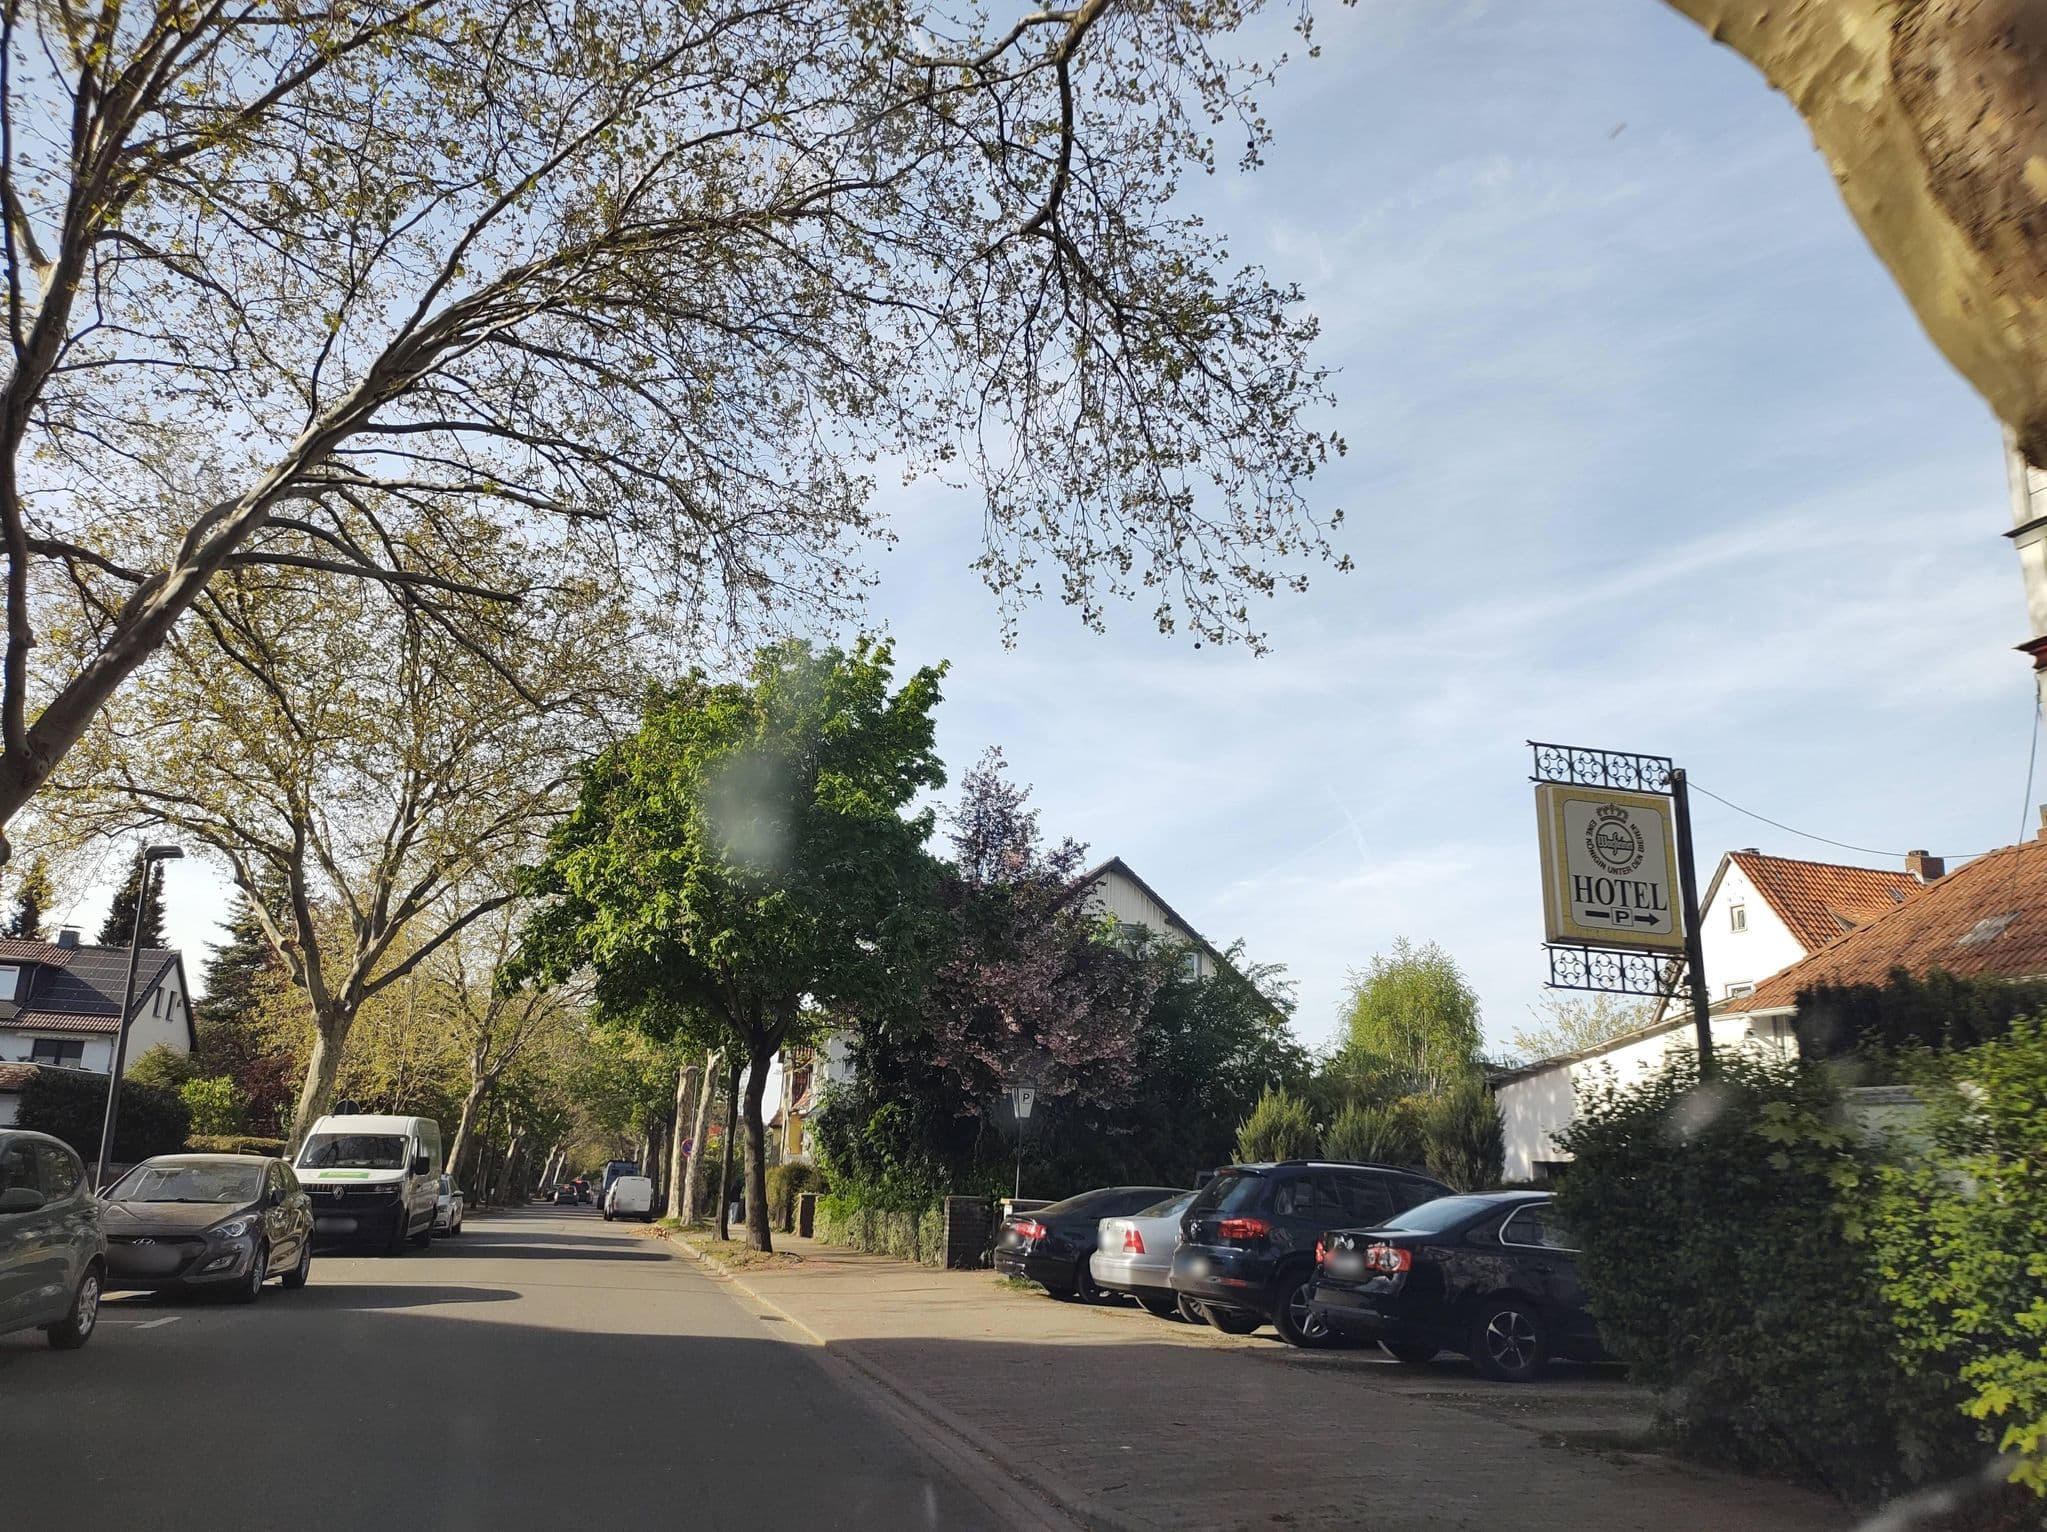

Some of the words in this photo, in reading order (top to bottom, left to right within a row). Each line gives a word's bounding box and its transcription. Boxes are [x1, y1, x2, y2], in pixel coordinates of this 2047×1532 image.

[1586, 819, 1598, 837] EINE
[1607, 866, 1633, 876] UNTER
[1632, 854, 1644, 869] DEN
[1571, 874, 1667, 911] HOTEL
[1615, 910, 1629, 923] P
[1023, 1093, 1030, 1103] P
